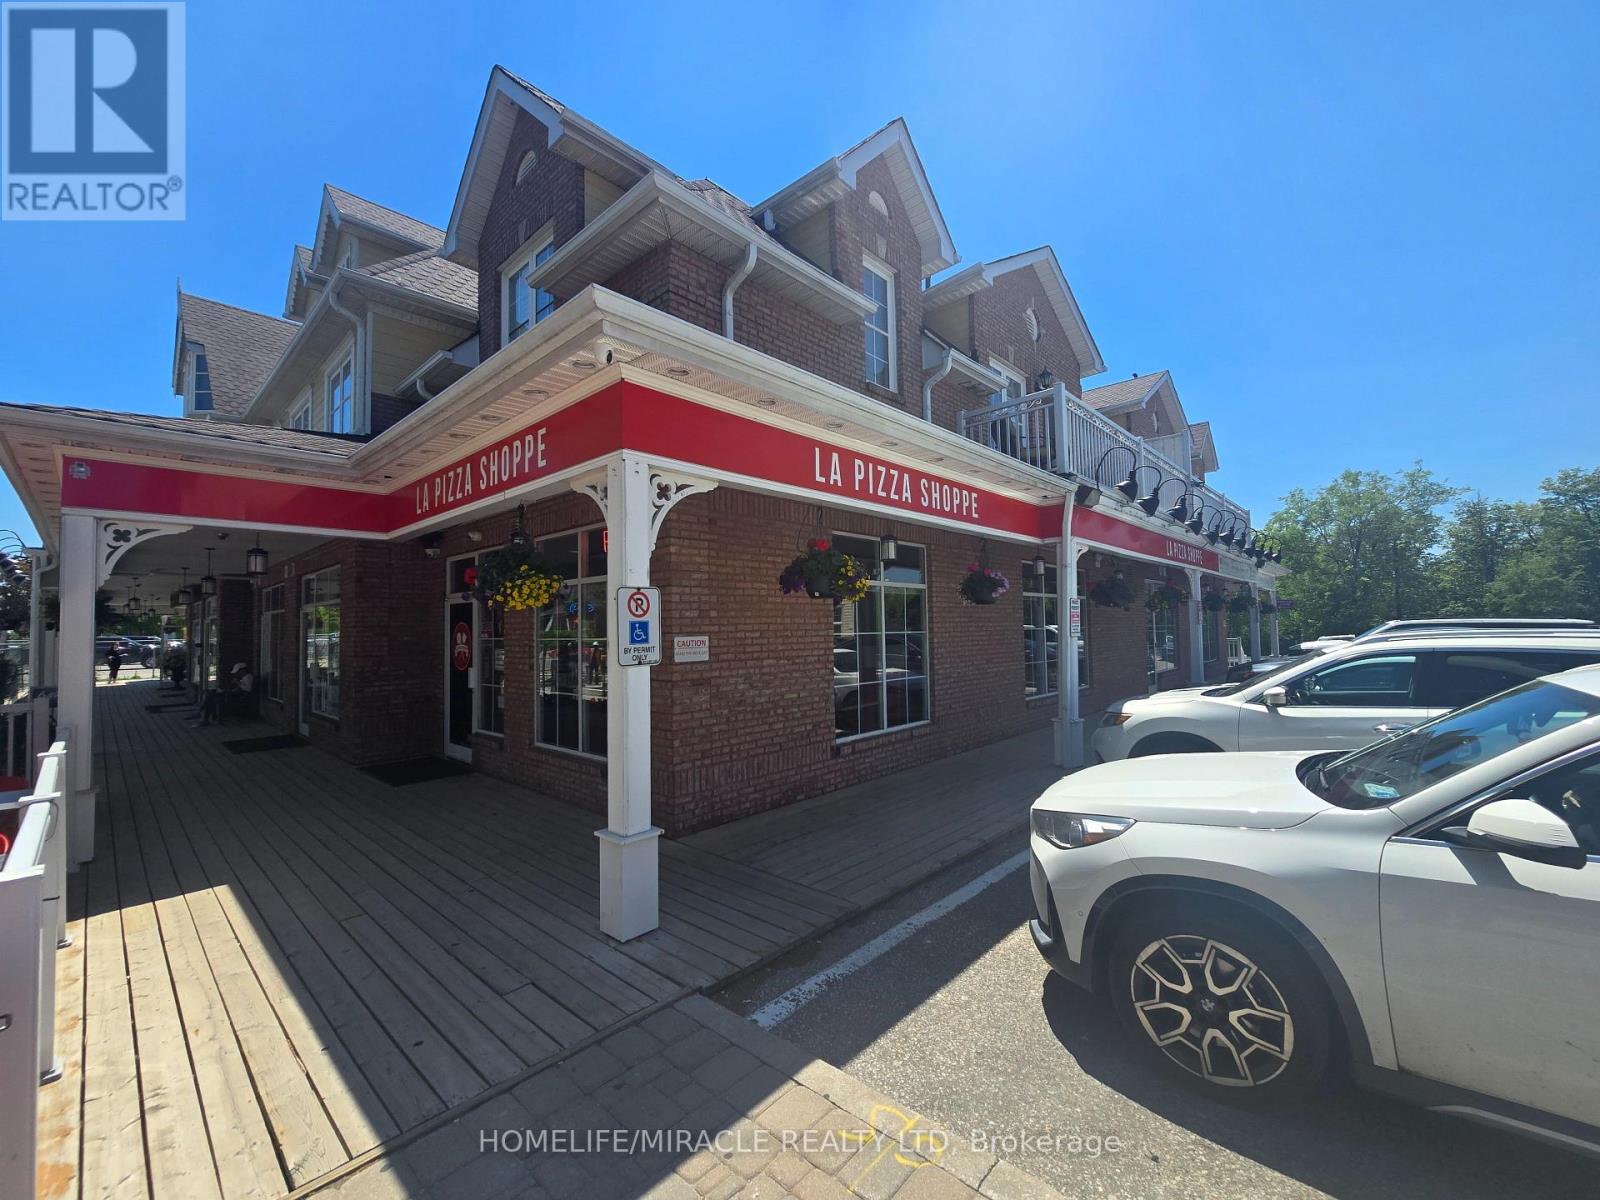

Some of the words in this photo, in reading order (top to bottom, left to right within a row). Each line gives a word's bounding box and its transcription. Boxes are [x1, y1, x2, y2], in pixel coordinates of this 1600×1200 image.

[416, 482, 430, 514] LA
[434, 463, 472, 508] PIZZA
[479, 427, 547, 490] SHOPPE
[814, 447, 842, 487] LA
[854, 458, 912, 503] PIZZA
[920, 478, 979, 518] SHOPPE
[1174, 541, 1187, 560] PIZZA
[623, 647, 632, 655] BY
[633, 646, 656, 654] PERMIT
[676, 639, 706, 648] CAUTION
[631, 654, 648, 662] ONLY
